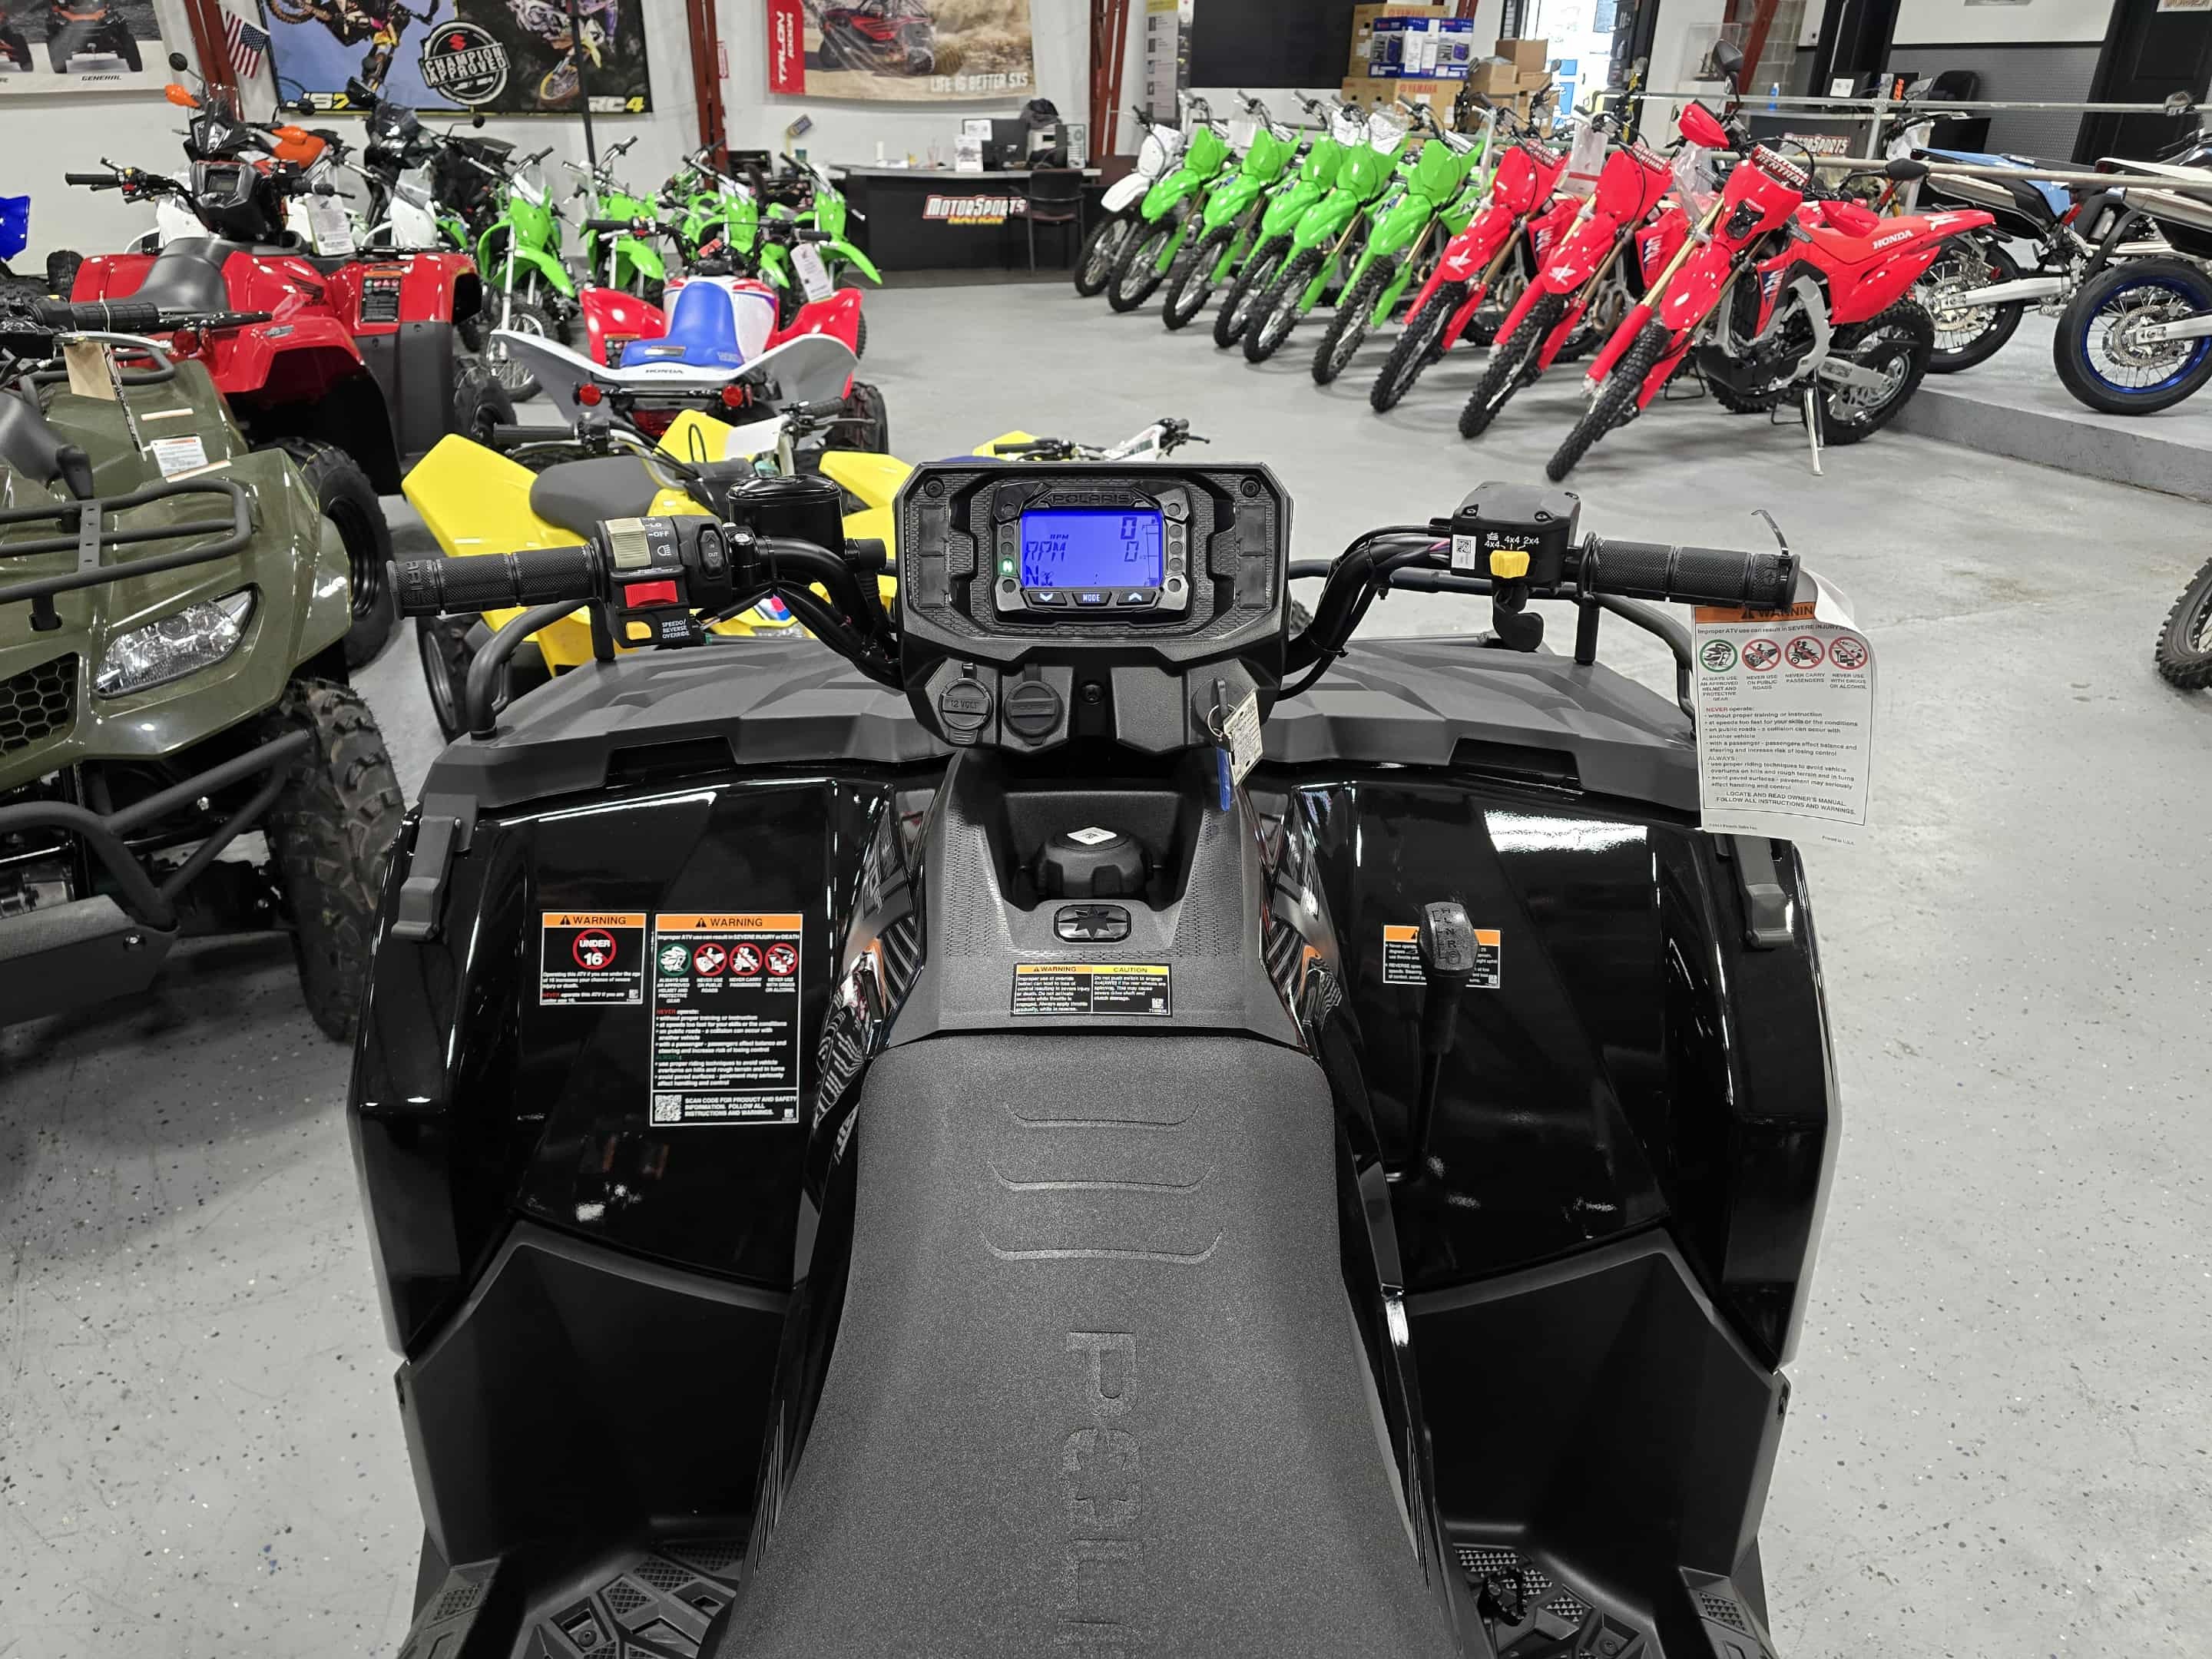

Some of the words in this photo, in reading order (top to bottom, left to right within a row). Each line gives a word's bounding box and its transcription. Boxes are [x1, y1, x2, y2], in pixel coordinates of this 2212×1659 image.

[777, 11, 787, 84] TALON
[425, 47, 503, 74] CHAMPION
[430, 57, 507, 84] APPROVED
[930, 76, 952, 92] LIFE
[955, 75, 965, 91] IS
[969, 73, 1007, 91] BETTER
[1873, 230, 1914, 250] HONDA
[1053, 494, 1131, 505] POLARIS
[1024, 541, 1066, 561] RPM
[1025, 565, 1039, 586] N
[1082, 594, 1101, 602] MODE
[662, 618, 687, 628] SPEEDO/
[662, 631, 690, 639] OVERRIDE
[951, 700, 959, 708] 12
[961, 700, 979, 709] VOLT
[1825, 781, 1853, 790] seriously
[1787, 793, 1817, 802] OWNER'S
[1758, 799, 1804, 808] INSTRUCTIONS
[1820, 804, 1856, 815] WARNINGS.
[573, 916, 627, 925] WARNING
[710, 918, 763, 927] WARNING
[579, 939, 611, 948] UNDER
[1447, 940, 1457, 949] R
[584, 952, 603, 965] 16
